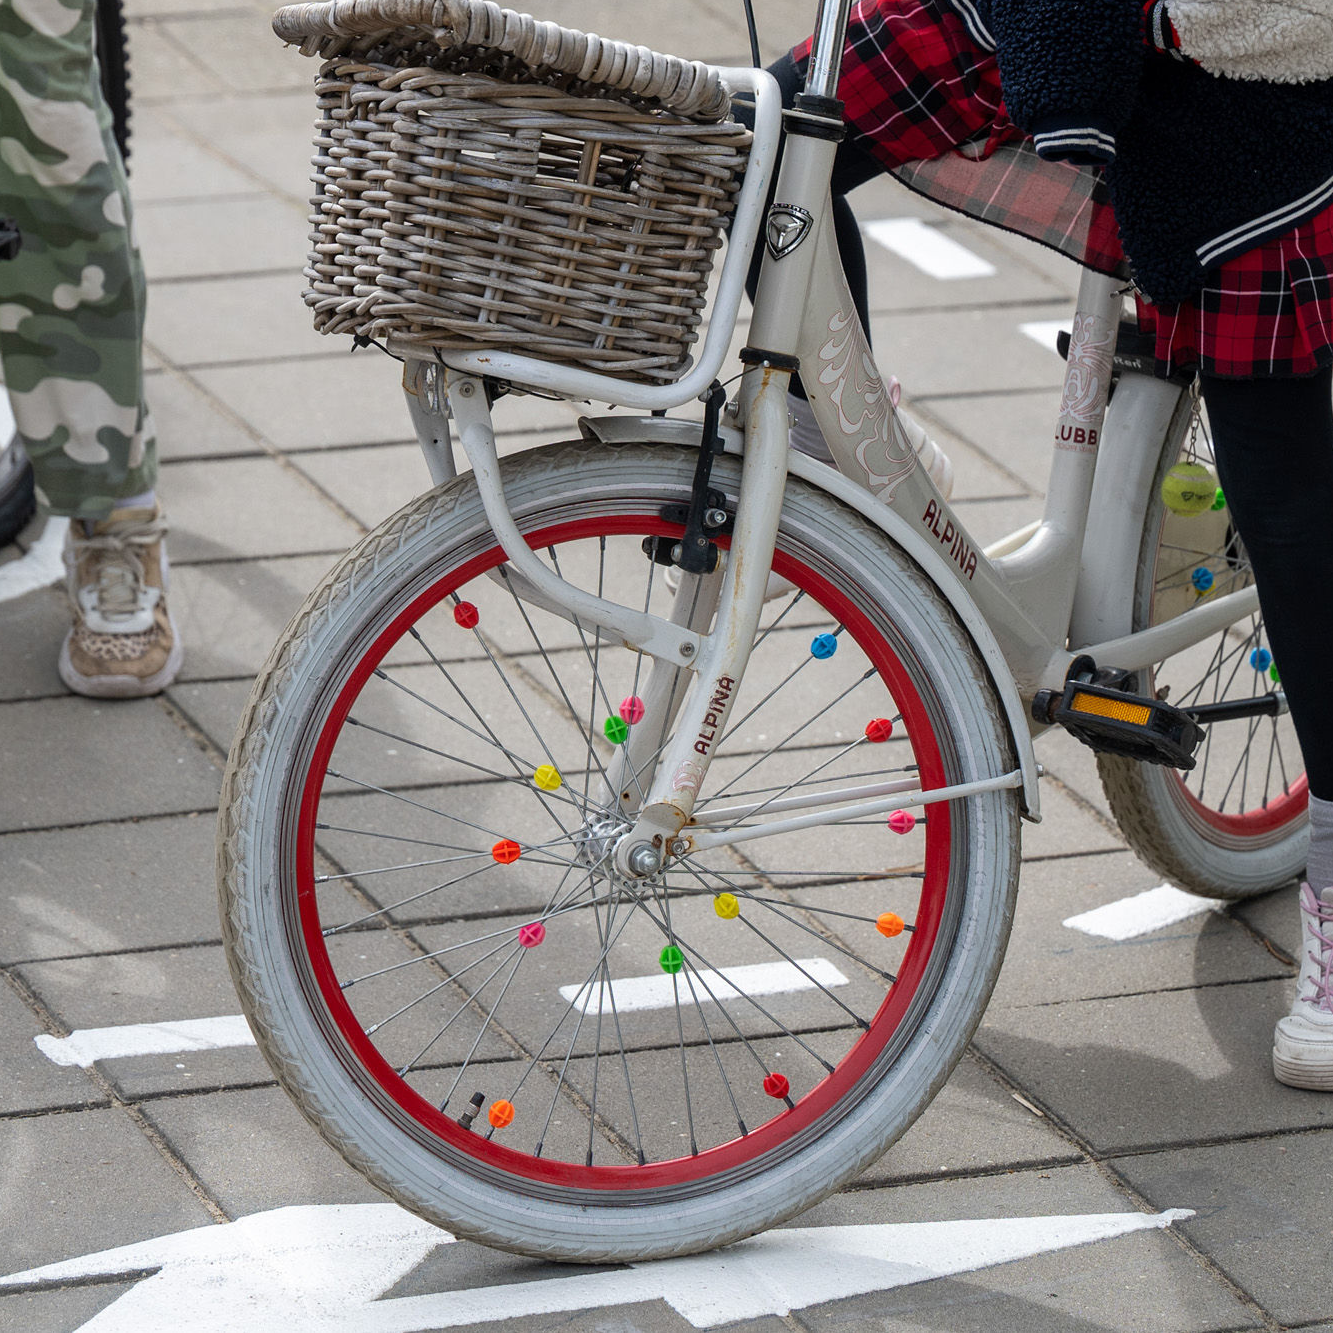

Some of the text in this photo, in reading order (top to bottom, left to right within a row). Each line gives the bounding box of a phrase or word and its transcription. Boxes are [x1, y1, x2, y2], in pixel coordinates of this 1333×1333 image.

[1055, 424, 1098, 446] UBB
[922, 498, 978, 581] ALPINA
[694, 676, 735, 755] ALPINA
